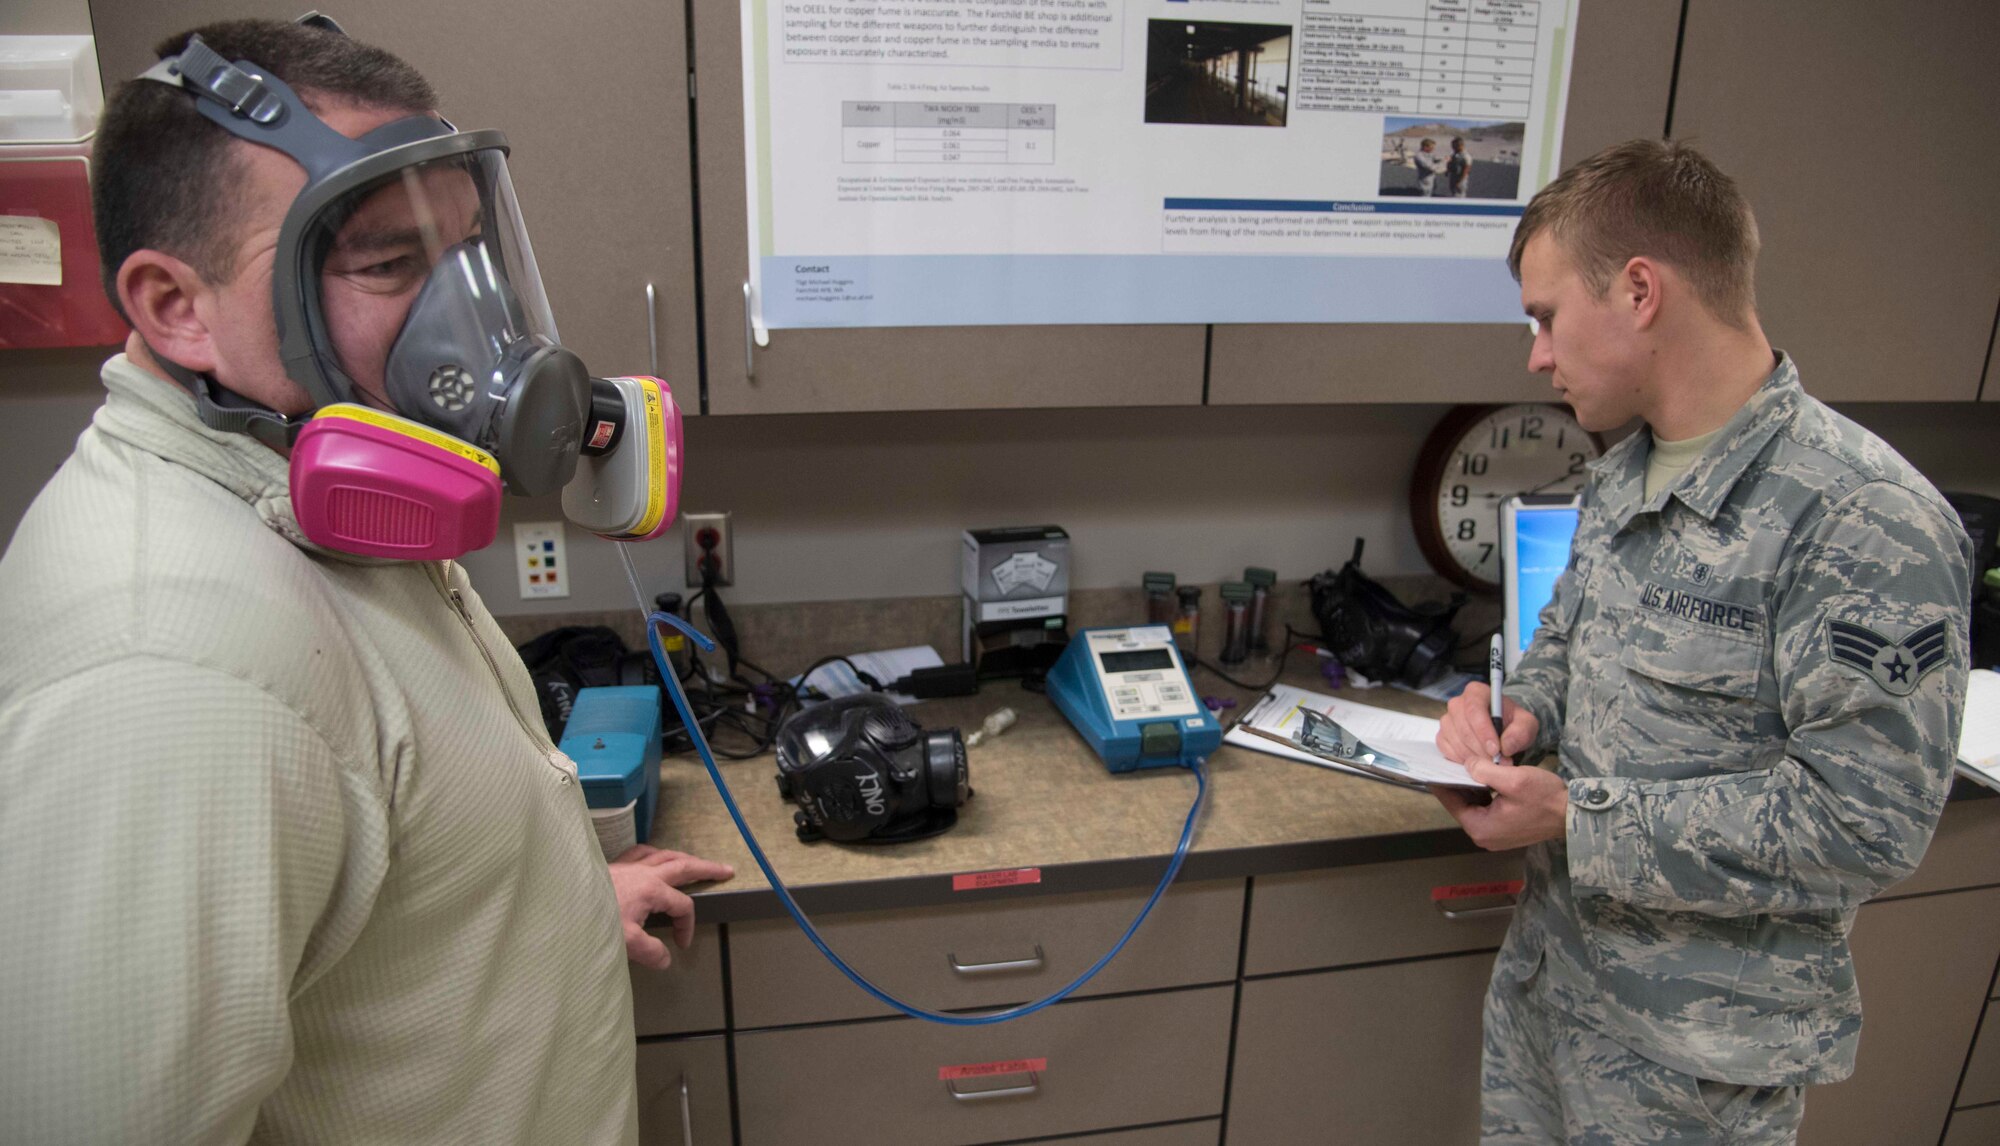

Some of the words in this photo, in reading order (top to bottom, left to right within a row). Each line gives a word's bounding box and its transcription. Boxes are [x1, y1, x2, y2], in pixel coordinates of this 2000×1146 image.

[785, 5, 801, 14] the
[828, 5, 842, 14] for
[844, 8, 875, 17] copper
[878, 6, 901, 15] fume
[913, 8, 960, 17] inaccurate.
[967, 8, 982, 17] The
[985, 10, 1022, 19] Fairchild
[1038, 11, 1059, 23] shop
[1070, 12, 1112, 21] additional
[786, 19, 827, 31] sampling
[829, 20, 842, 29] for
[845, 20, 859, 29] the
[862, 21, 901, 30] different
[903, 24, 943, 33] weapons
[956, 23, 988, 32] further
[990, 24, 1037, 35] distinguish
[1038, 25, 1053, 34] the
[1055, 25, 1099, 34] difference
[786, 33, 826, 42] between
[828, 36, 860, 45] copper
[862, 34, 882, 43] dust
[884, 35, 901, 44] and
[903, 37, 934, 47] copper
[936, 36, 959, 45] fume
[972, 37, 987, 46] the
[990, 38, 1028, 49] sampling
[1031, 38, 1057, 47] media
[786, 49, 828, 58] exposure
[839, 47, 885, 59] accurately
[887, 48, 948, 57] characterized.
[857, 141, 880, 150] Copper
[1332, 203, 1375, 212] Conclusion
[1165, 215, 1196, 223] Further
[1197, 216, 1228, 226] analysis
[1238, 216, 1259, 227] being
[1261, 217, 1302, 227] performed
[1316, 217, 1348, 226] different
[1352, 220, 1381, 228] weapon
[1384, 219, 1412, 229] systems
[1424, 219, 1461, 228] determine
[1462, 220, 1474, 228] the
[1476, 223, 1508, 231] exposure
[1165, 227, 1188, 235] levels
[1189, 227, 1208, 235] from
[1210, 227, 1230, 238] firing
[1243, 228, 1255, 236] the
[1257, 228, 1284, 236] rounds
[1286, 228, 1301, 237] and
[1313, 229, 1351, 237] determine
[1360, 230, 1390, 238] accurate
[1392, 232, 1425, 241] exposure
[1428, 231, 1446, 239] level.
[795, 264, 830, 273] Contact
[1520, 416, 1543, 439] 12
[1490, 427, 1509, 449] 11
[1462, 453, 1489, 476] 10
[1568, 452, 1585, 474] 2
[1450, 484, 1469, 506] 9
[1457, 518, 1476, 541] 8
[1478, 543, 1494, 564] 7
[1642, 583, 1664, 608] U.S.
[1664, 590, 1690, 618] AIR
[1688, 597, 1754, 632] FORCE
[855, 772, 885, 816] ONLY
